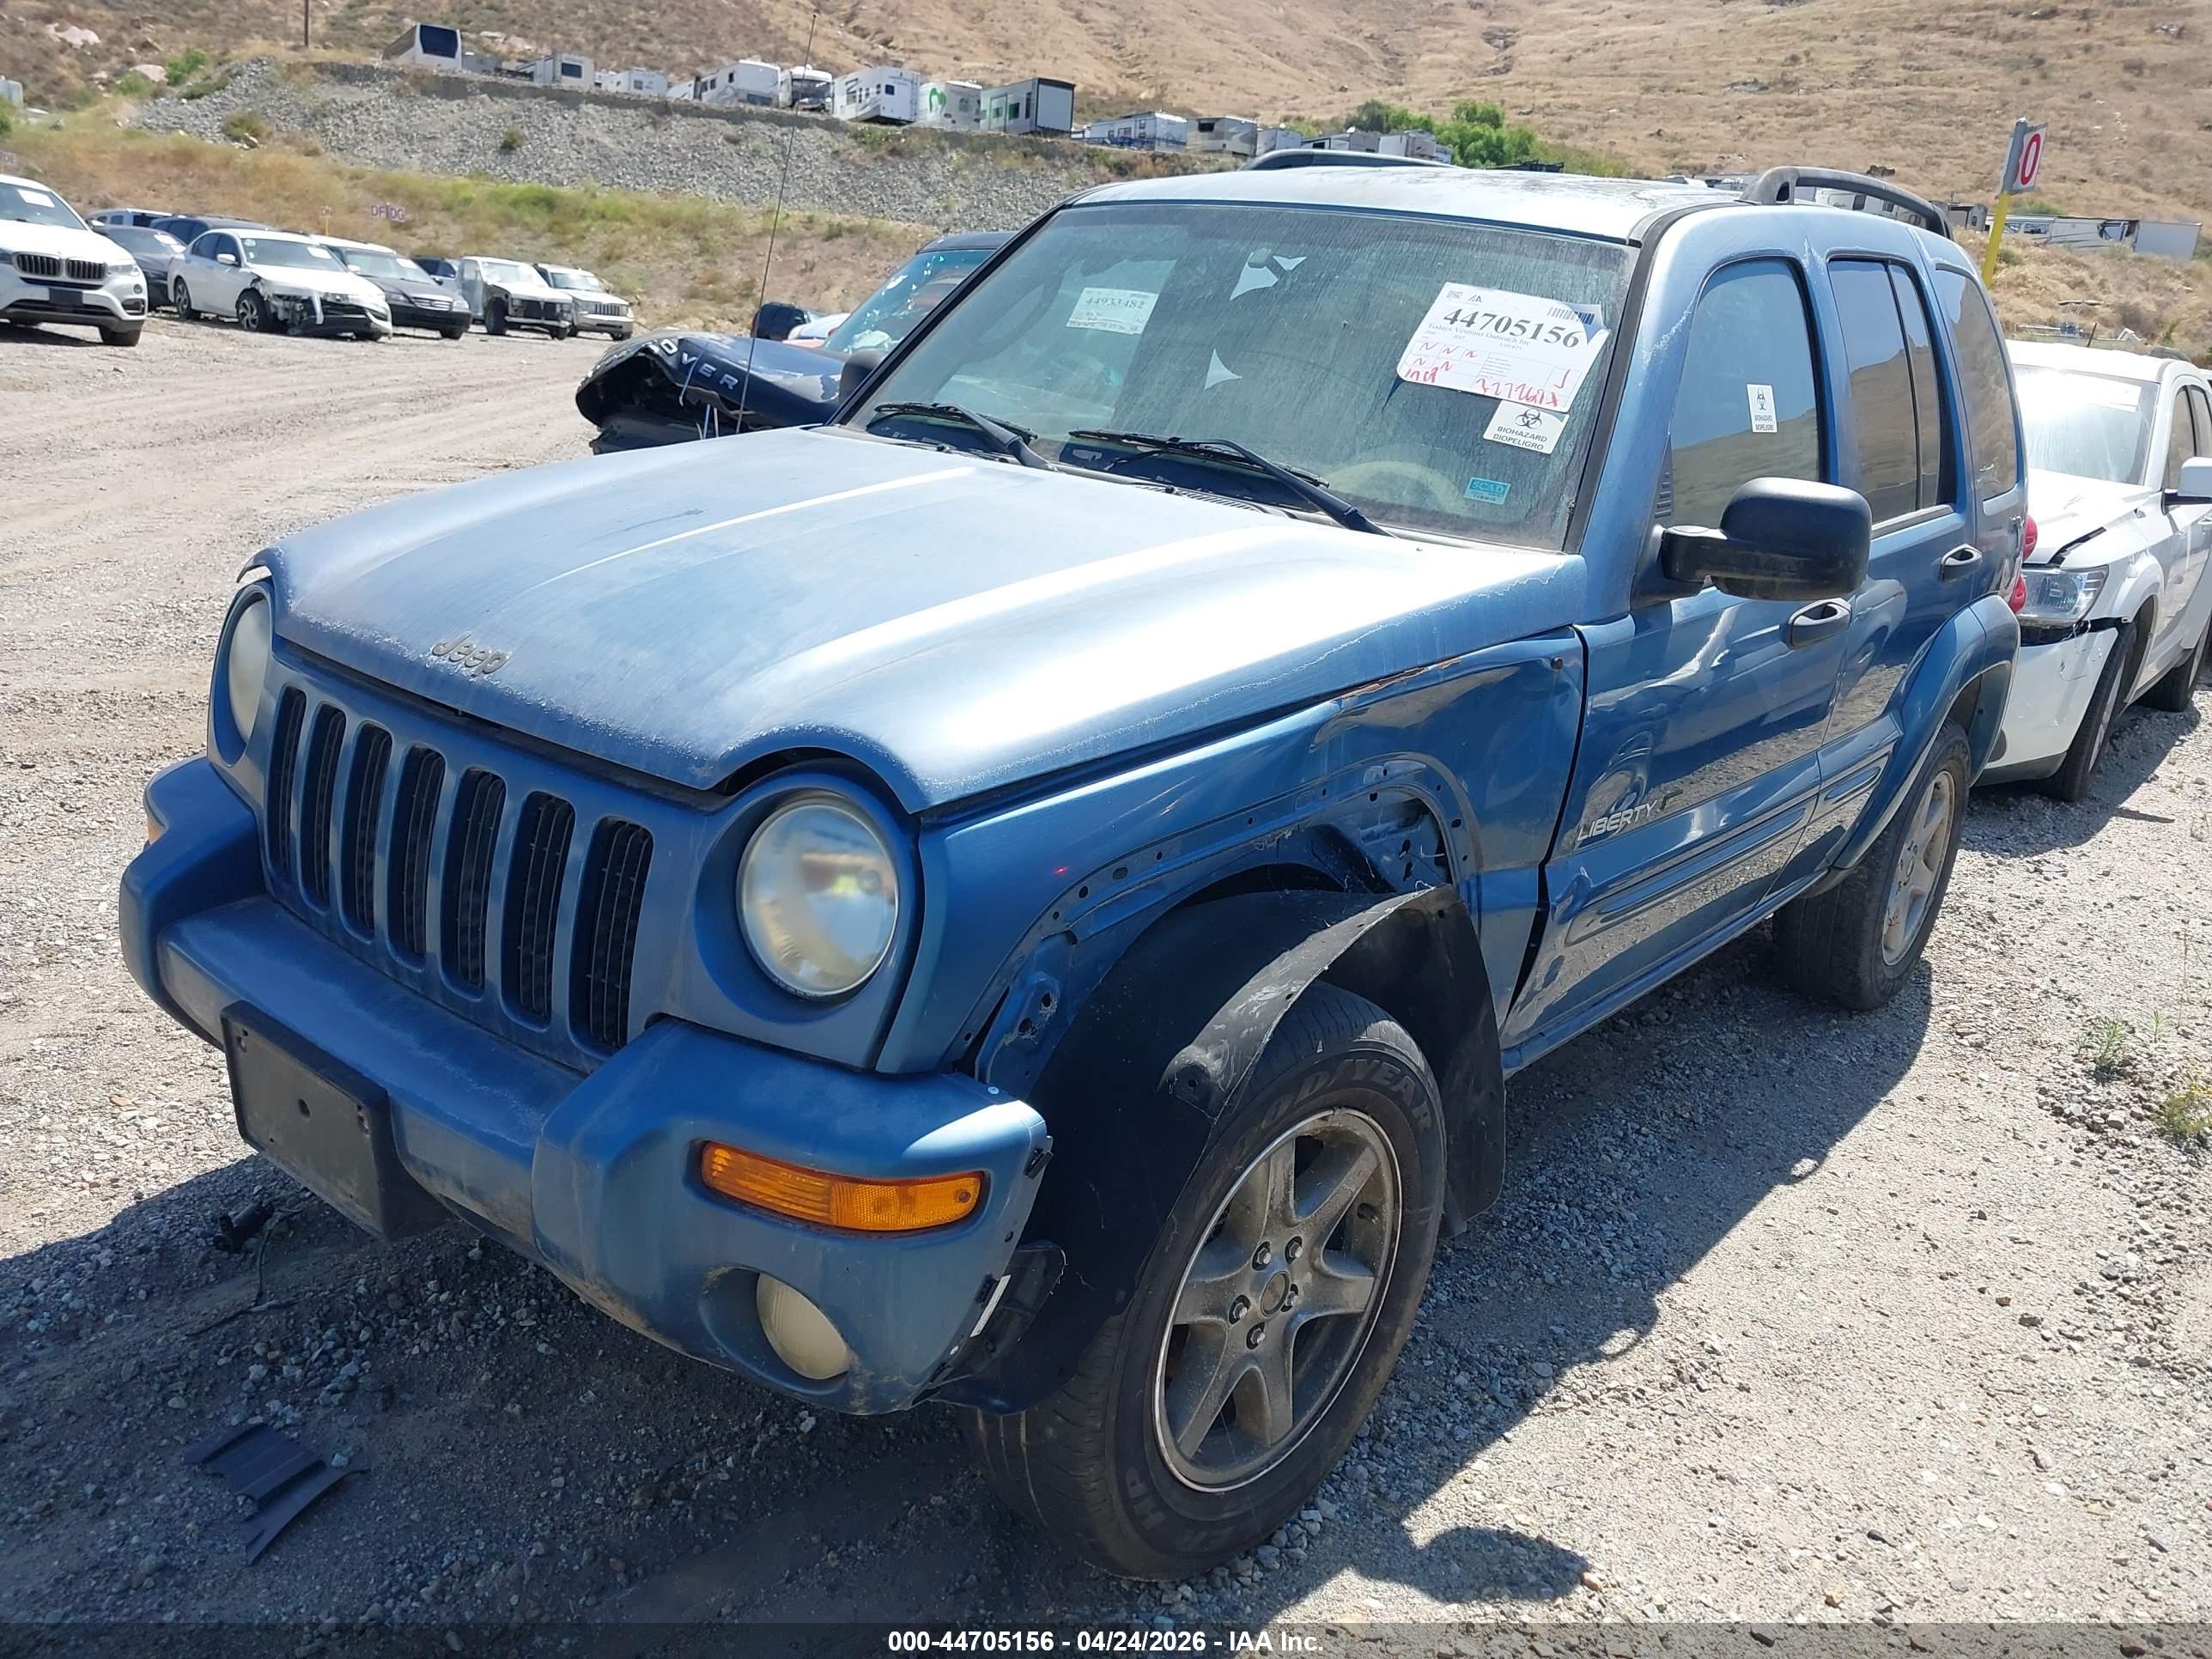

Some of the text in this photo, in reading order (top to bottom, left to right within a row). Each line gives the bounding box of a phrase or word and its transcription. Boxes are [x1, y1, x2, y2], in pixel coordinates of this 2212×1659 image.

[1443, 308, 1583, 348] 44705156
[1497, 426, 1547, 442] BIOHAZARD
[431, 631, 511, 678] Jeep
[1577, 799, 1658, 842] LIBERTY
